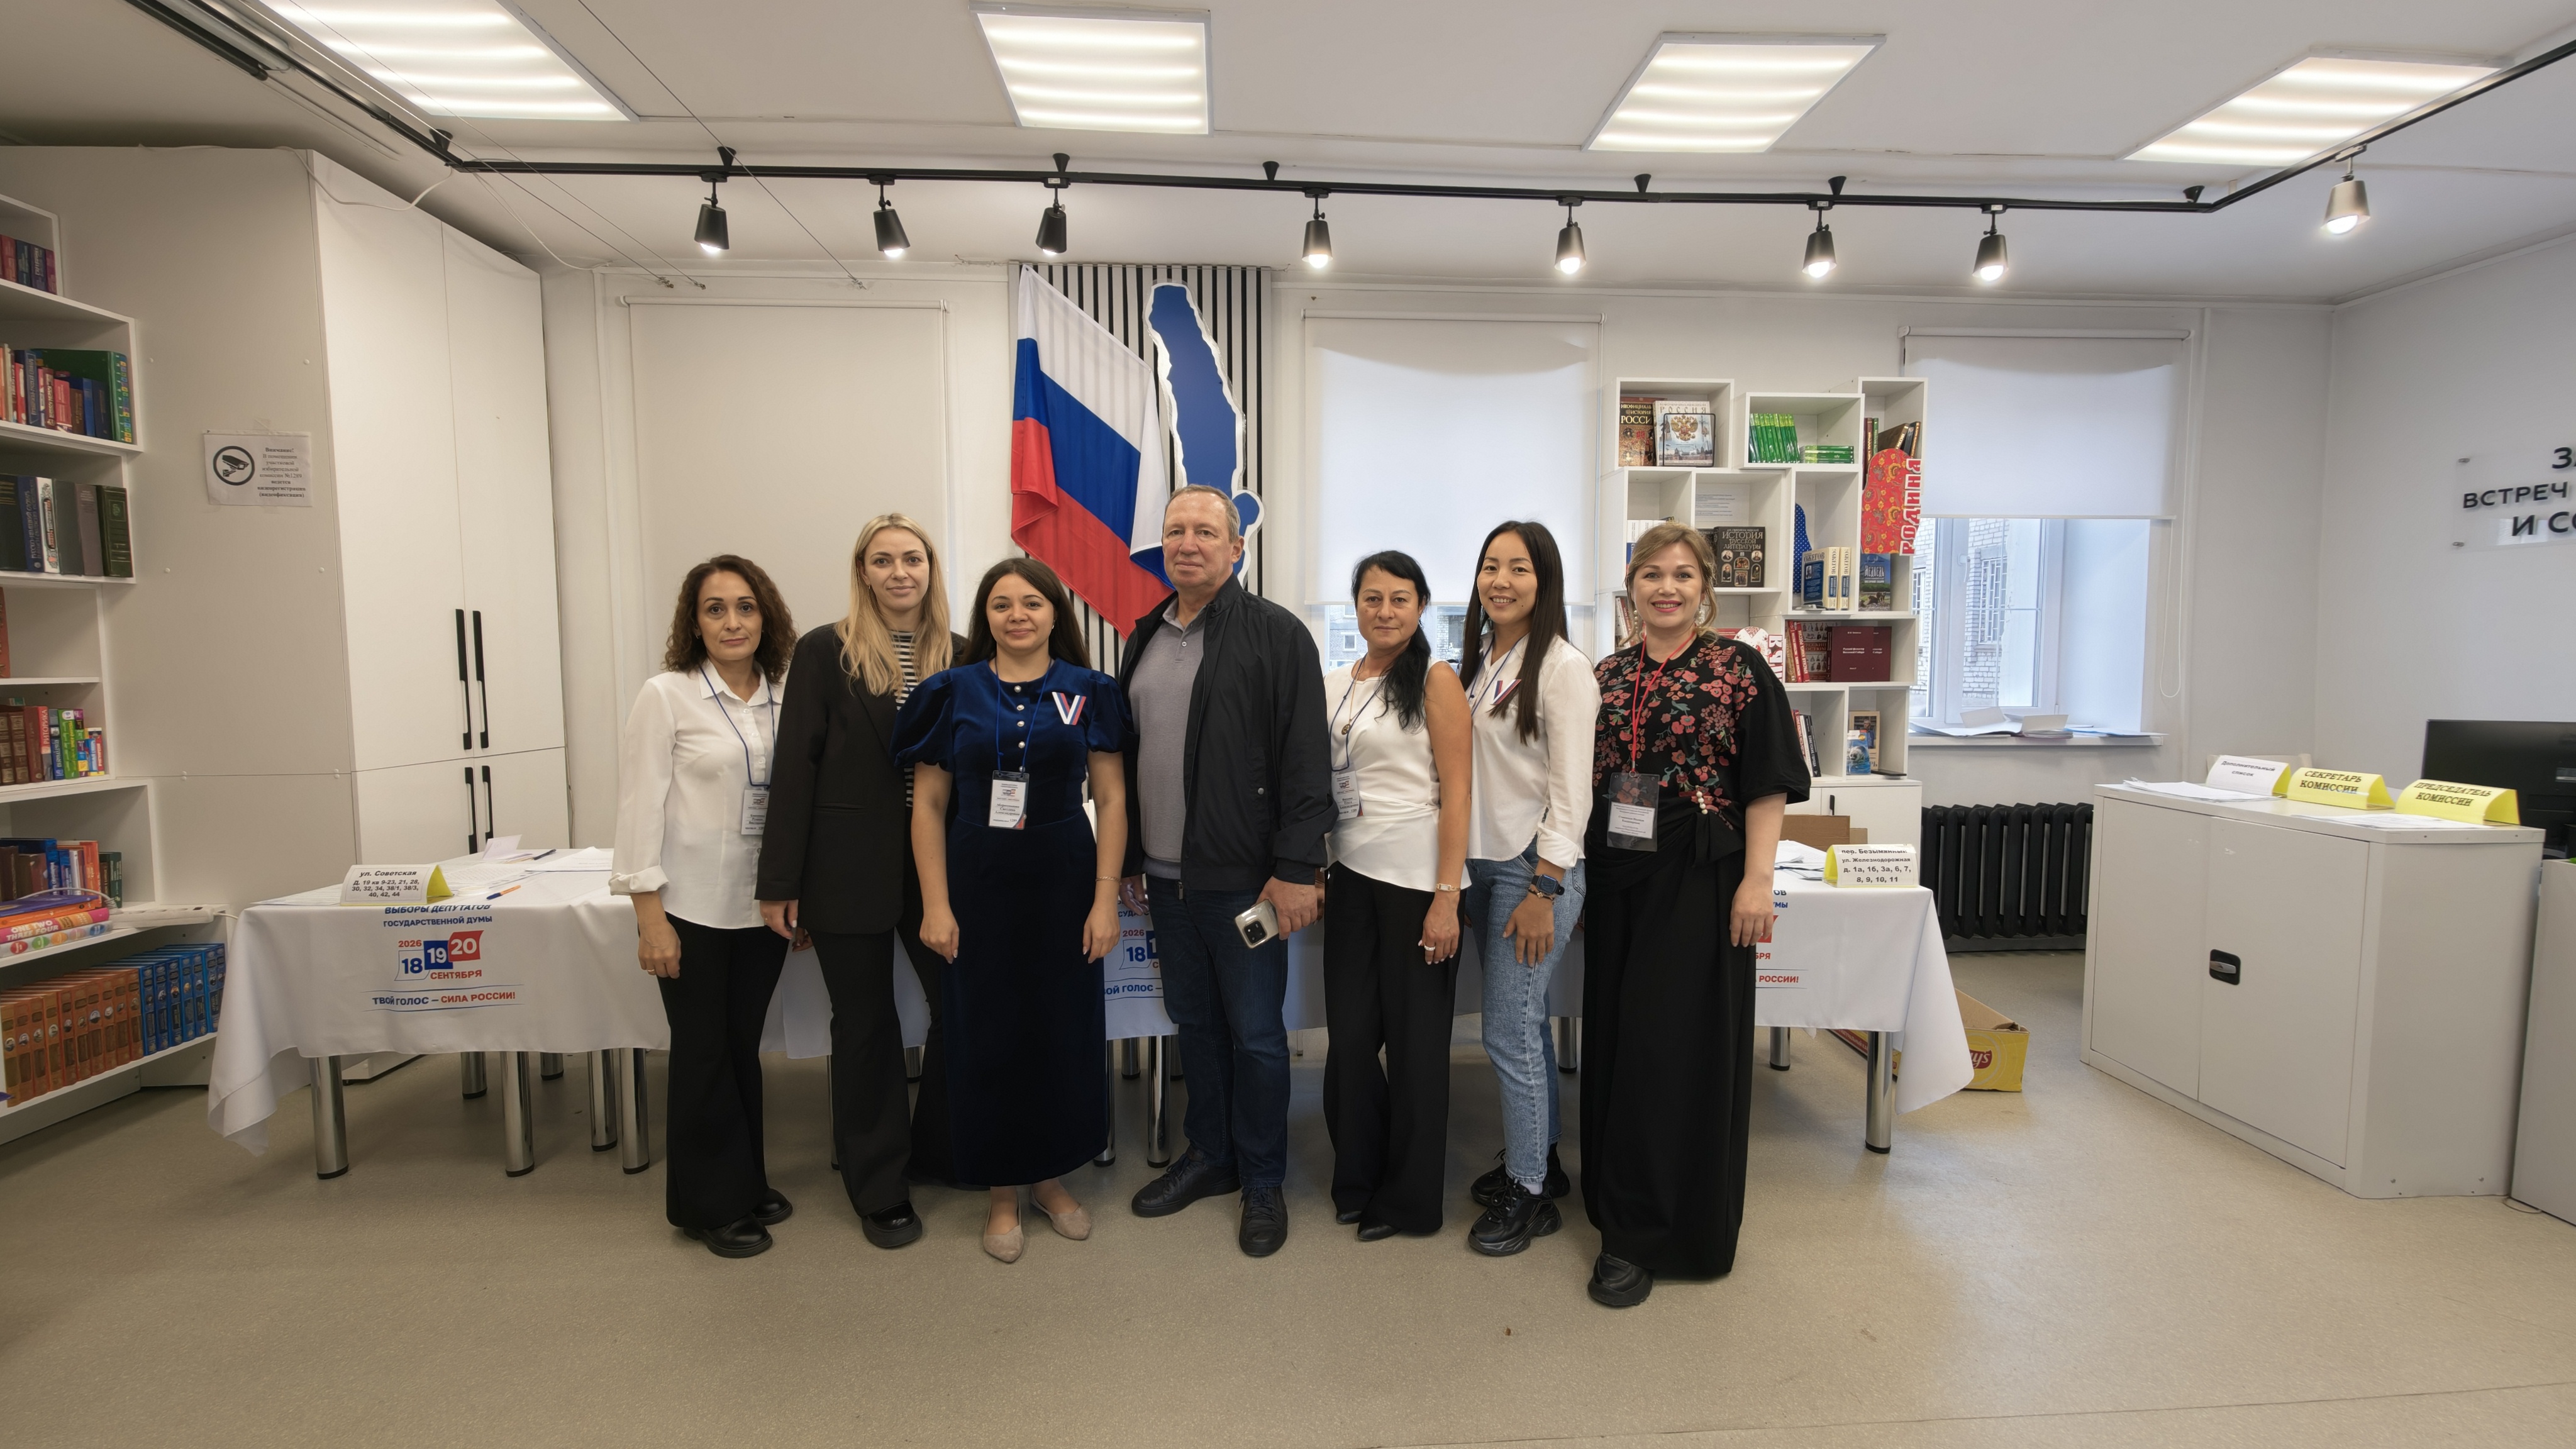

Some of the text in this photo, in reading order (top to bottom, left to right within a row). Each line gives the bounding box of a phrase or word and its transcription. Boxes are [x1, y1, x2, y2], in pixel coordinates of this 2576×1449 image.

[2551, 447, 2576, 469] З
[2463, 481, 2568, 509] ВСТРЕЧ
[1900, 458, 1922, 556] РОДИНА
[2511, 511, 2576, 536] И С
[1722, 531, 1763, 539] ИСТОРИЯ
[1804, 552, 1825, 563] ОЖЕГОВ
[41, 709, 50, 745] РИТОРИКА
[2221, 761, 2275, 772] Дополнительный
[2304, 770, 2362, 783] СЕКРЕТАРЬ
[2299, 779, 2358, 794] КОМИССИИ
[2414, 782, 2492, 797] ПРЕДСЕДАТЕЛЬ
[2415, 792, 2475, 807] КОМИССИИ
[384, 904, 492, 914] ВЫБОРЫ ДЕПУТАТОВ
[11, 919, 53, 933] ONE TWO
[383, 916, 465, 927] ГОСУДАРСТВЕННОЙ
[6, 931, 33, 941] THREE
[35, 925, 59, 935] FOUR
[398, 940, 422, 948] 2026
[451, 938, 477, 955] 20
[426, 947, 447, 963] 19
[1126, 947, 1146, 962] 18
[401, 957, 423, 974] 18
[430, 970, 482, 980] СЕНТЯБРЯ
[1122, 984, 1153, 992] ГОЛОС
[372, 996, 394, 1005] ТВОЙ
[396, 997, 429, 1006] ГОЛОС
[470, 992, 515, 1001] РОССИИ!
